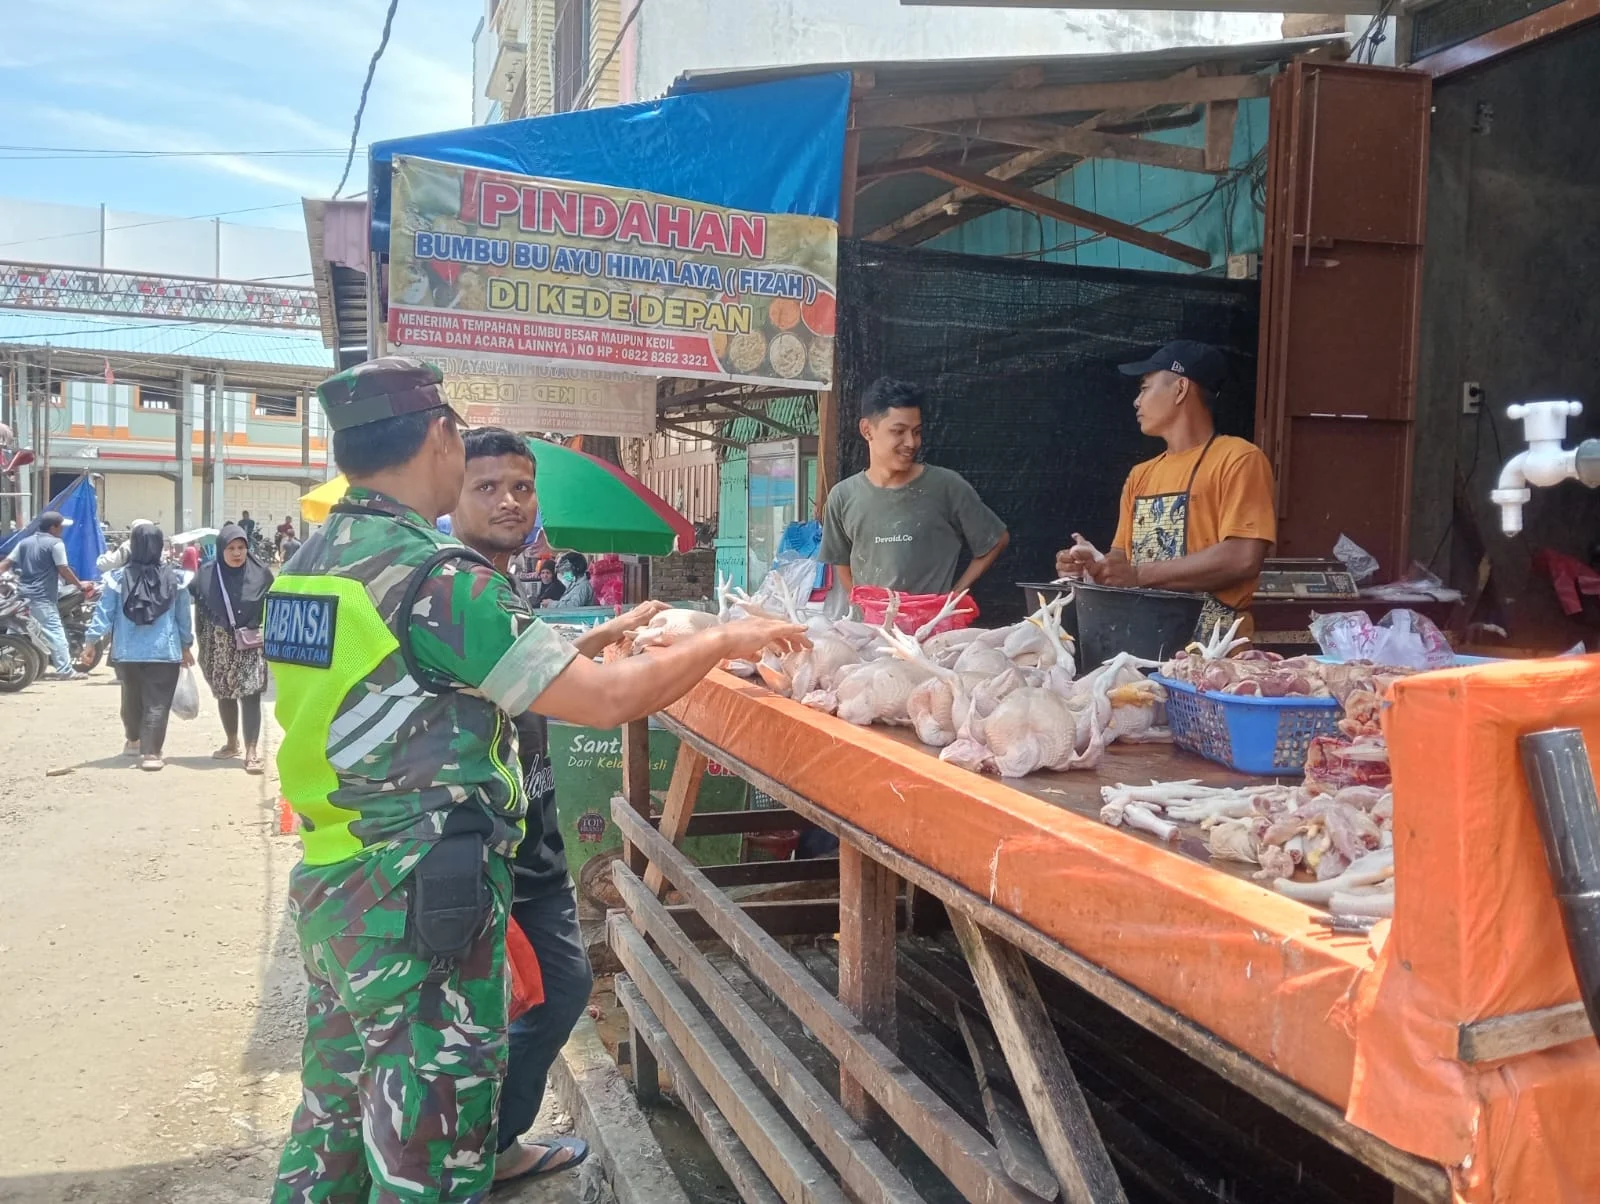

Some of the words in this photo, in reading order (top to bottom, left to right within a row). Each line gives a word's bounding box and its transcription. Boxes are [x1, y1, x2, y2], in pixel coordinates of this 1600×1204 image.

[479, 181, 766, 259] PINDAHAN
[415, 231, 509, 266] BUMBU
[513, 242, 549, 270] BU
[552, 247, 600, 276] AYU
[606, 253, 722, 290] HIMALAYA
[488, 277, 530, 313] DI
[537, 283, 632, 323] KEDE
[637, 293, 752, 334] DEPAN
[399, 314, 459, 329] MENERIMA
[462, 318, 520, 335] TEMPAHAN
[524, 324, 562, 339] BUMBU
[564, 328, 598, 342] BESAR
[601, 332, 643, 348] MAUPUN
[646, 336, 675, 350] KECIL
[405, 329, 442, 342] PESTA
[446, 333, 471, 345] DAN
[475, 335, 515, 349] ACARA
[518, 340, 568, 354] LAINNYA
[577, 346, 594, 357] NO
[597, 347, 613, 358] HP
[621, 350, 648, 362] 0822
[651, 352, 678, 364] 8262
[681, 355, 708, 367] 3221
[569, 734, 623, 754] Sant
[568, 756, 593, 768] Dari
[597, 757, 623, 769] Kela
[648, 759, 668, 771] sli
